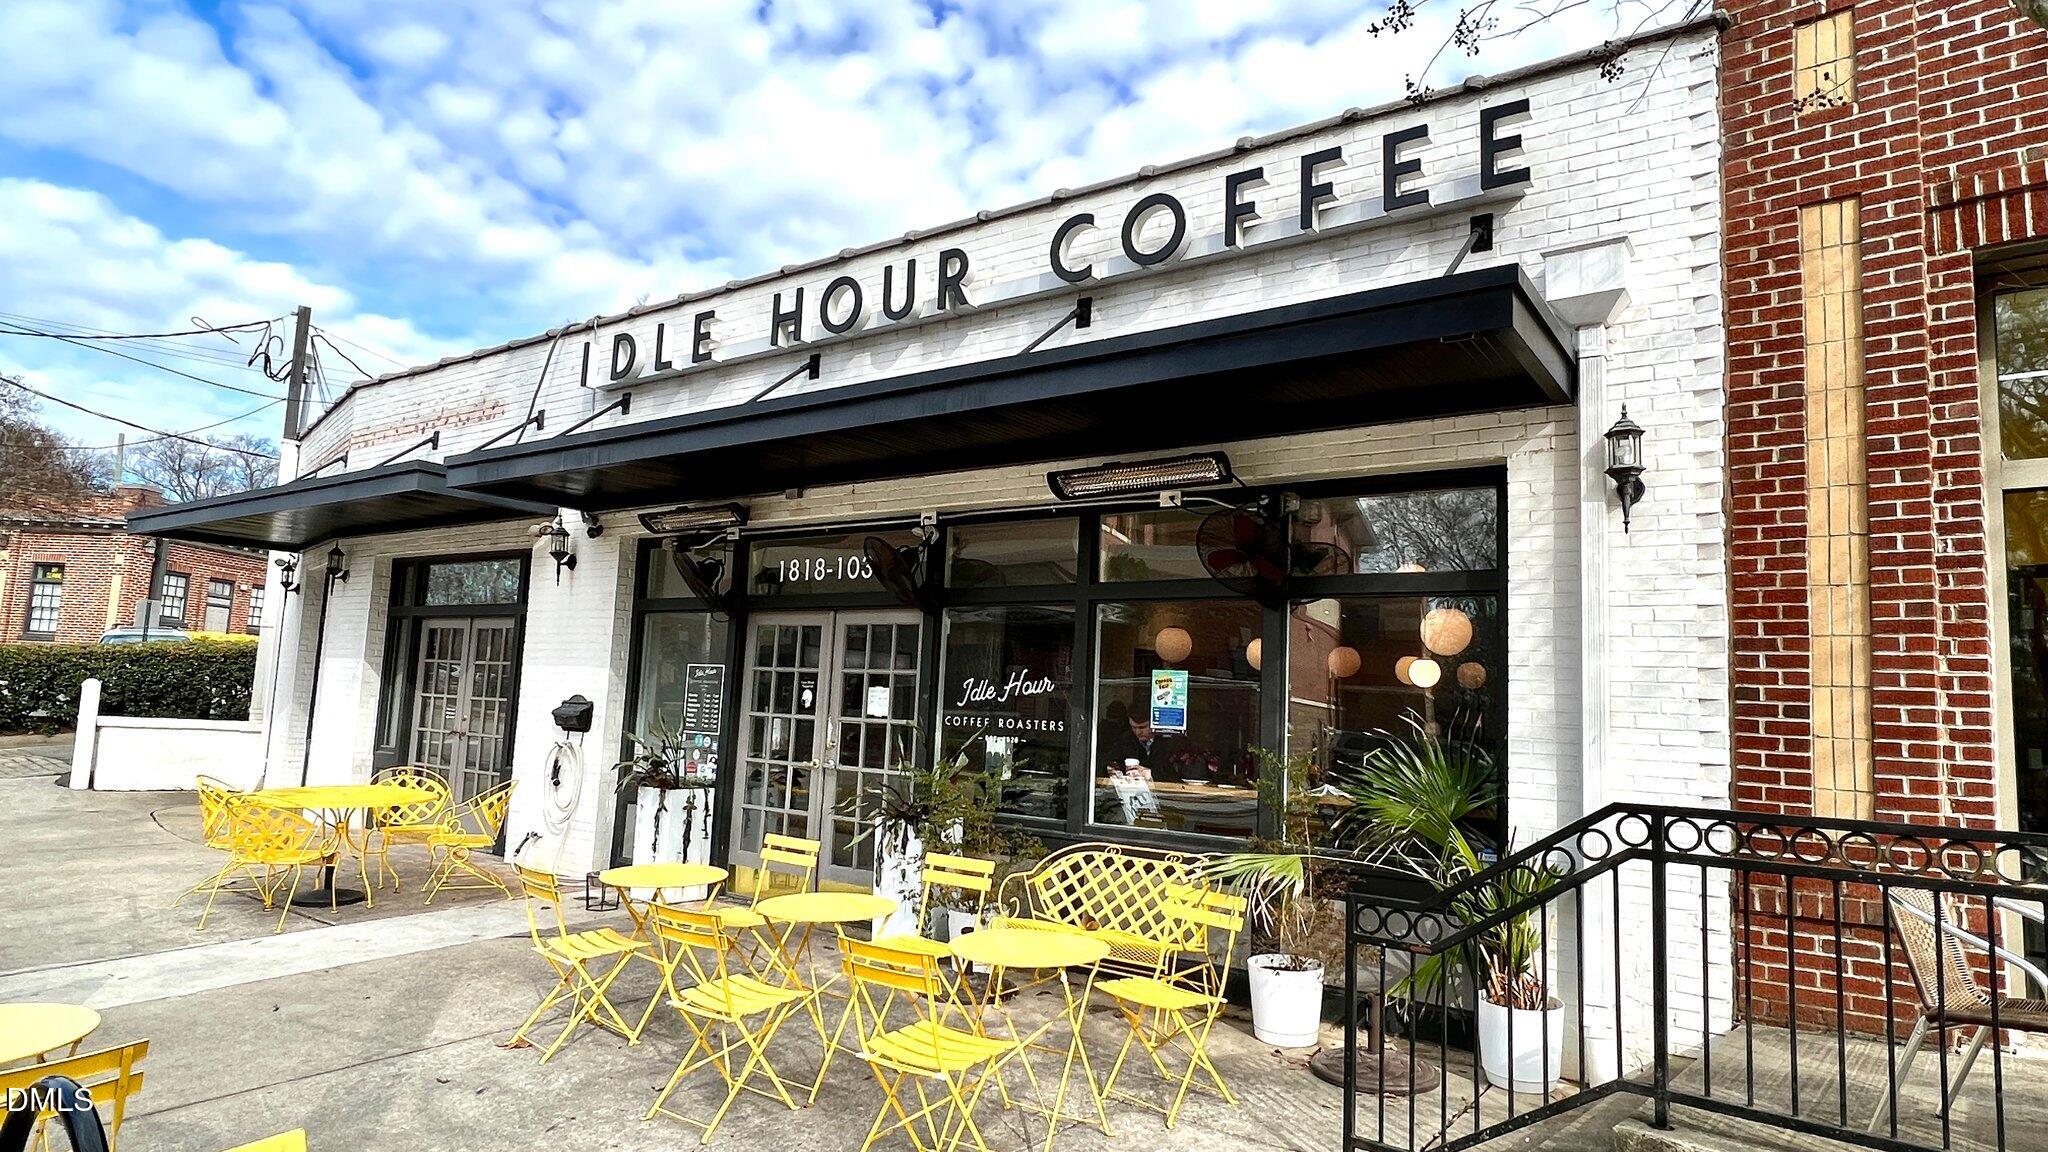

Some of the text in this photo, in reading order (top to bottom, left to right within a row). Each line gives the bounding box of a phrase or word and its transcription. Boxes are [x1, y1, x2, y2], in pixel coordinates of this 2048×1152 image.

[580, 98, 1532, 387] IDLE HOUR COFFEE
[957, 669, 1055, 707] Idle Hour
[998, 719, 1064, 731] ROASTERS
